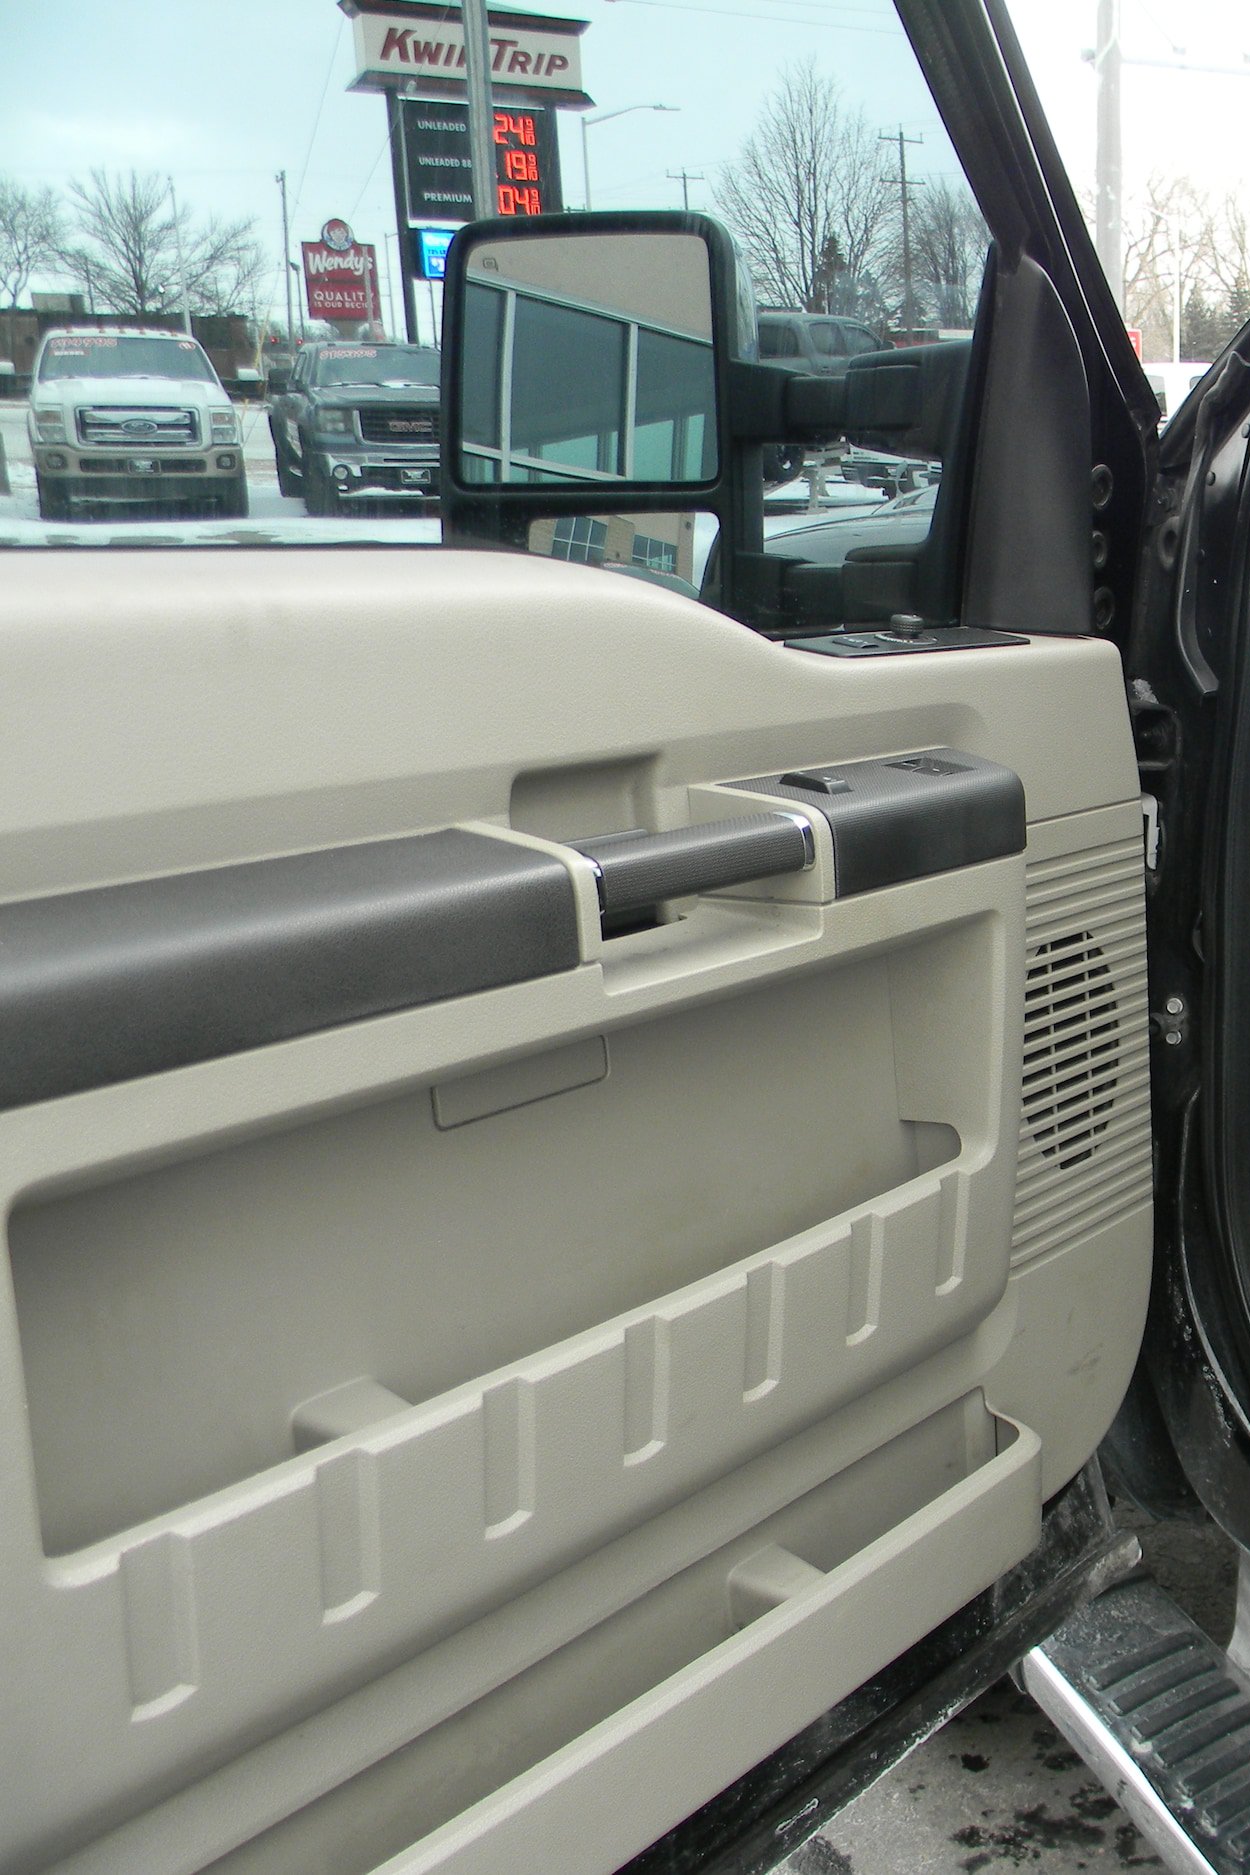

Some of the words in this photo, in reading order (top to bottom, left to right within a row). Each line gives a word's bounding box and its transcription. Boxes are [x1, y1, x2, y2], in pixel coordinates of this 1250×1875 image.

[490, 38, 569, 77] TRIP
[417, 119, 467, 132] UNLEADED
[419, 156, 460, 168] UNLEADED
[424, 191, 473, 204] PREMIUM
[308, 249, 373, 276] Wendys
